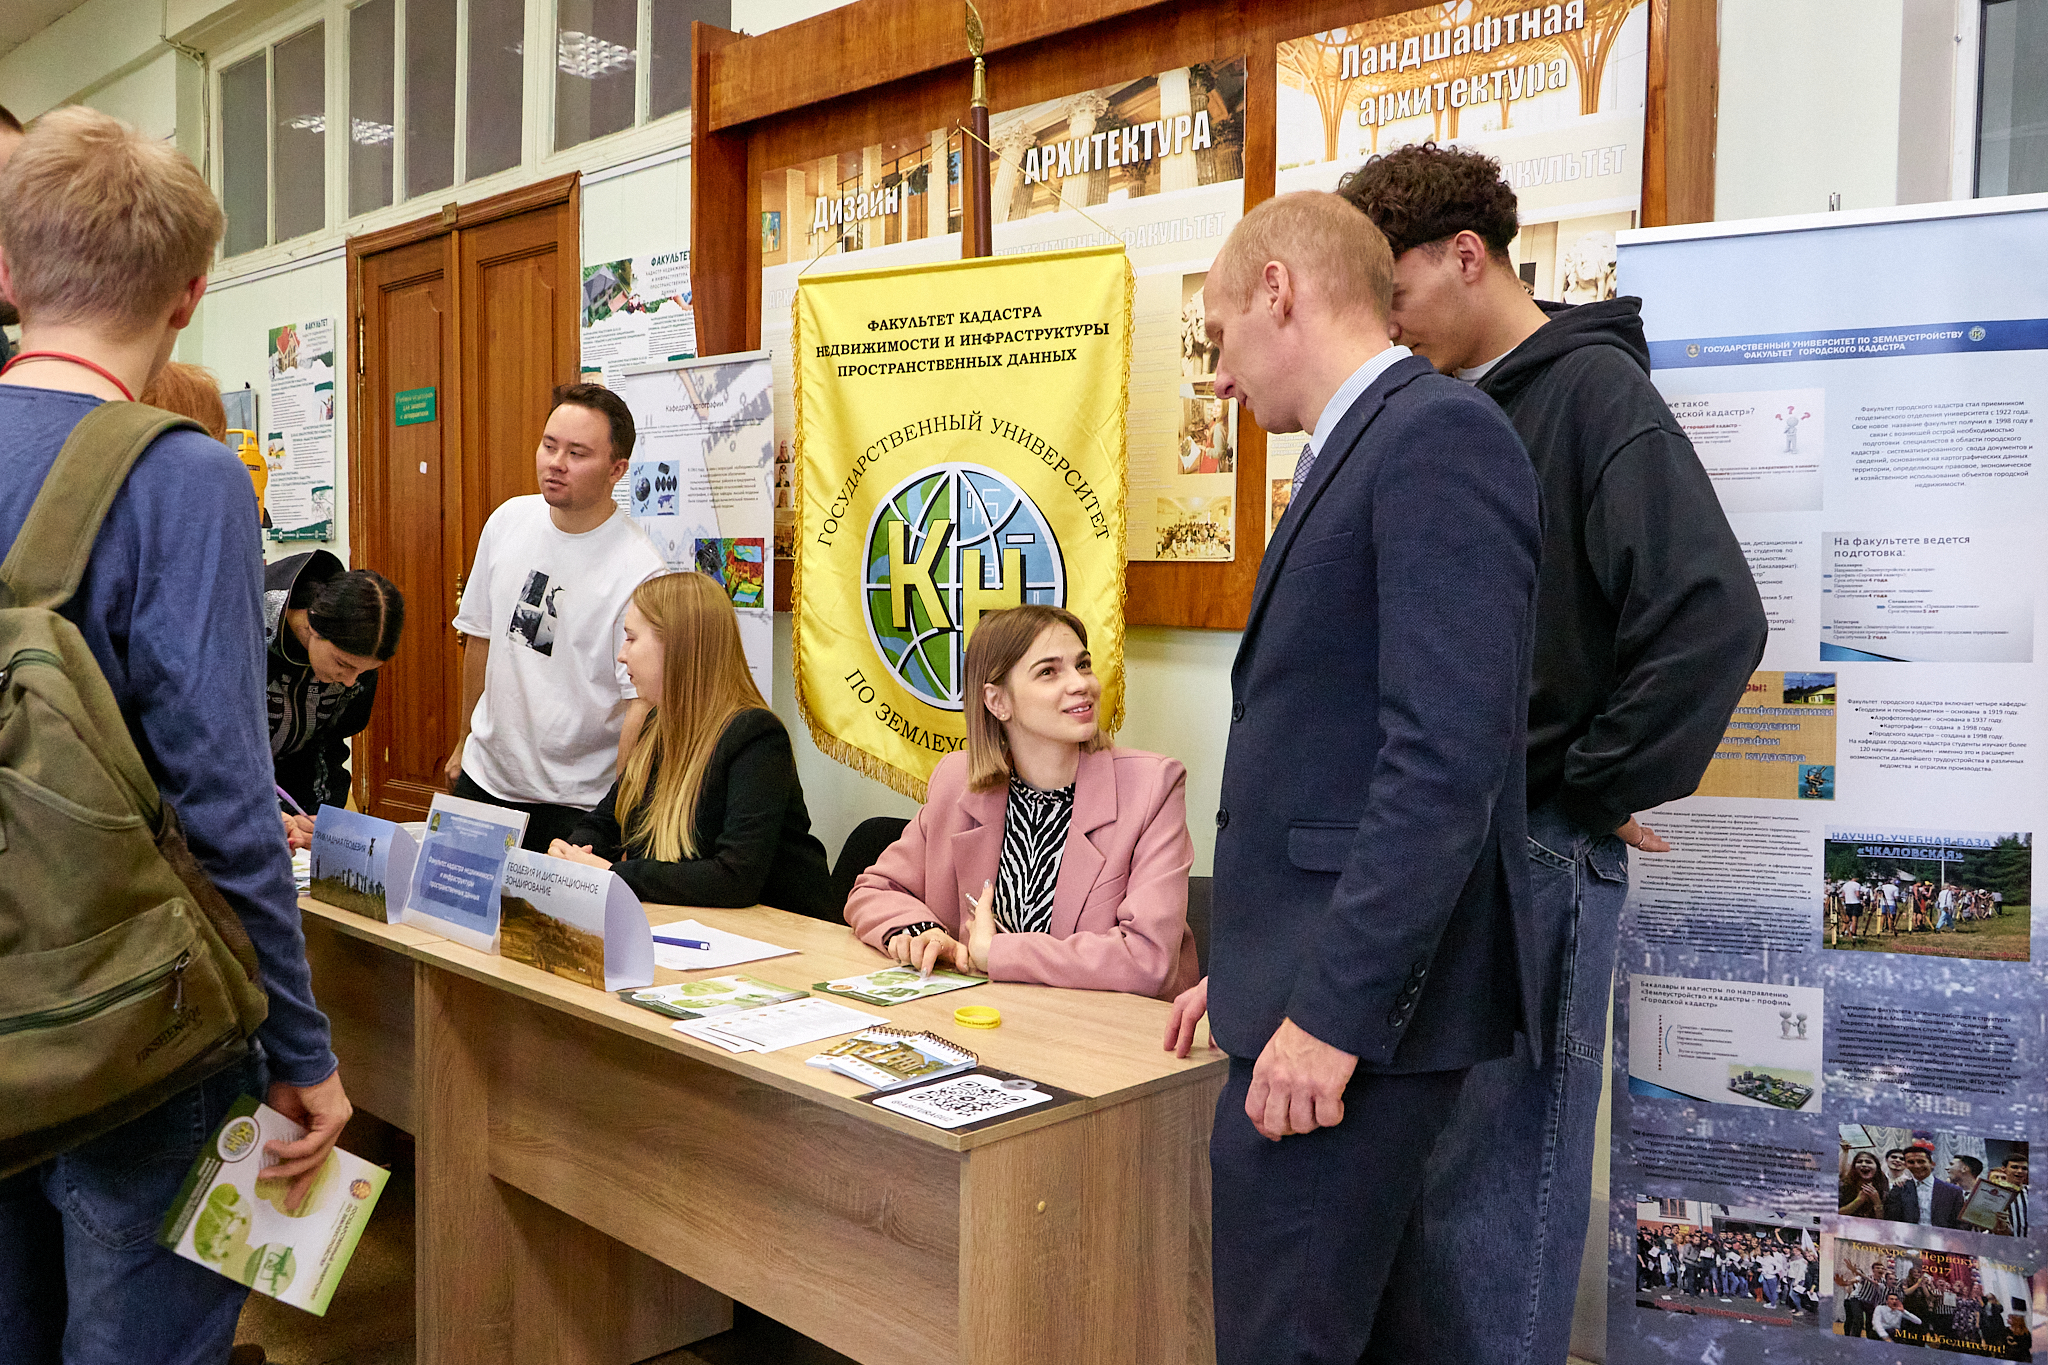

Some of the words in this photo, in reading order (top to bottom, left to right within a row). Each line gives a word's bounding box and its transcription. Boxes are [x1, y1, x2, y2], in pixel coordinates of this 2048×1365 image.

[1340, 0, 1585, 81] Ландшафтная
[1359, 58, 1568, 127] архитектура
[1024, 110, 1211, 185] АРХИТЕКТУРА
[1502, 144, 1626, 191] АКУЛЬТЕТ
[813, 183, 898, 234] Дизайн
[1121, 211, 1226, 250] ФАКУЛЬТЕТ
[868, 313, 954, 332] ФАКУЛЬТЕТ
[960, 305, 1042, 324] КАДАСТРА
[816, 337, 940, 358] НЕДВИЖИМОСТИ
[944, 335, 956, 348] И
[960, 322, 1110, 347] ИНФРАСТРУКТУРЫ
[1703, 341, 1790, 354] ГОСУДАРСТВЕННЫЙ
[1792, 337, 1856, 349] УНИВЕРСИТЕТ
[1858, 336, 1870, 345] ПО
[1872, 330, 1964, 344] ЗЕМЛЕУСТРОЙСТВУ
[1744, 349, 1792, 359] ФАКУЛЬТЕТ
[1798, 346, 1856, 356] ГОРОДСКОГО
[1858, 343, 1906, 353] КАДАСТРА
[837, 354, 1002, 378] ПРОСТРАНСТВЕННЫХ
[1007, 348, 1077, 368] ДАННЫХ
[1706, 407, 1755, 417] кадастр»?
[817, 410, 983, 547] ГОСУДАРСТВЕННЫЙ
[990, 416, 1110, 540] УНИВЕРСИТЕТ
[1834, 537, 1850, 546] На
[1852, 536, 1920, 547] факультете
[1923, 536, 1970, 545] ведется
[1834, 549, 1906, 558] подготовка:
[844, 668, 876, 704] ПО
[1745, 752, 1806, 763] кадастра
[1857, 846, 1964, 860] «ЧКАЛОВСКАЯ»
[505, 875, 551, 896] ЗОНДИРОВАНИЕ
[507, 862, 536, 878] ГЕОДЕЗИЯ
[542, 870, 599, 894] ДИСТАНЦИОННОЕ
[1640, 981, 1679, 990] Бакалавры
[1737, 989, 1789, 998] направлению
[1852, 1242, 1906, 1258] Конкурс
[1921, 1264, 1952, 1275] 2017
[1895, 1329, 1918, 1341] Мы
